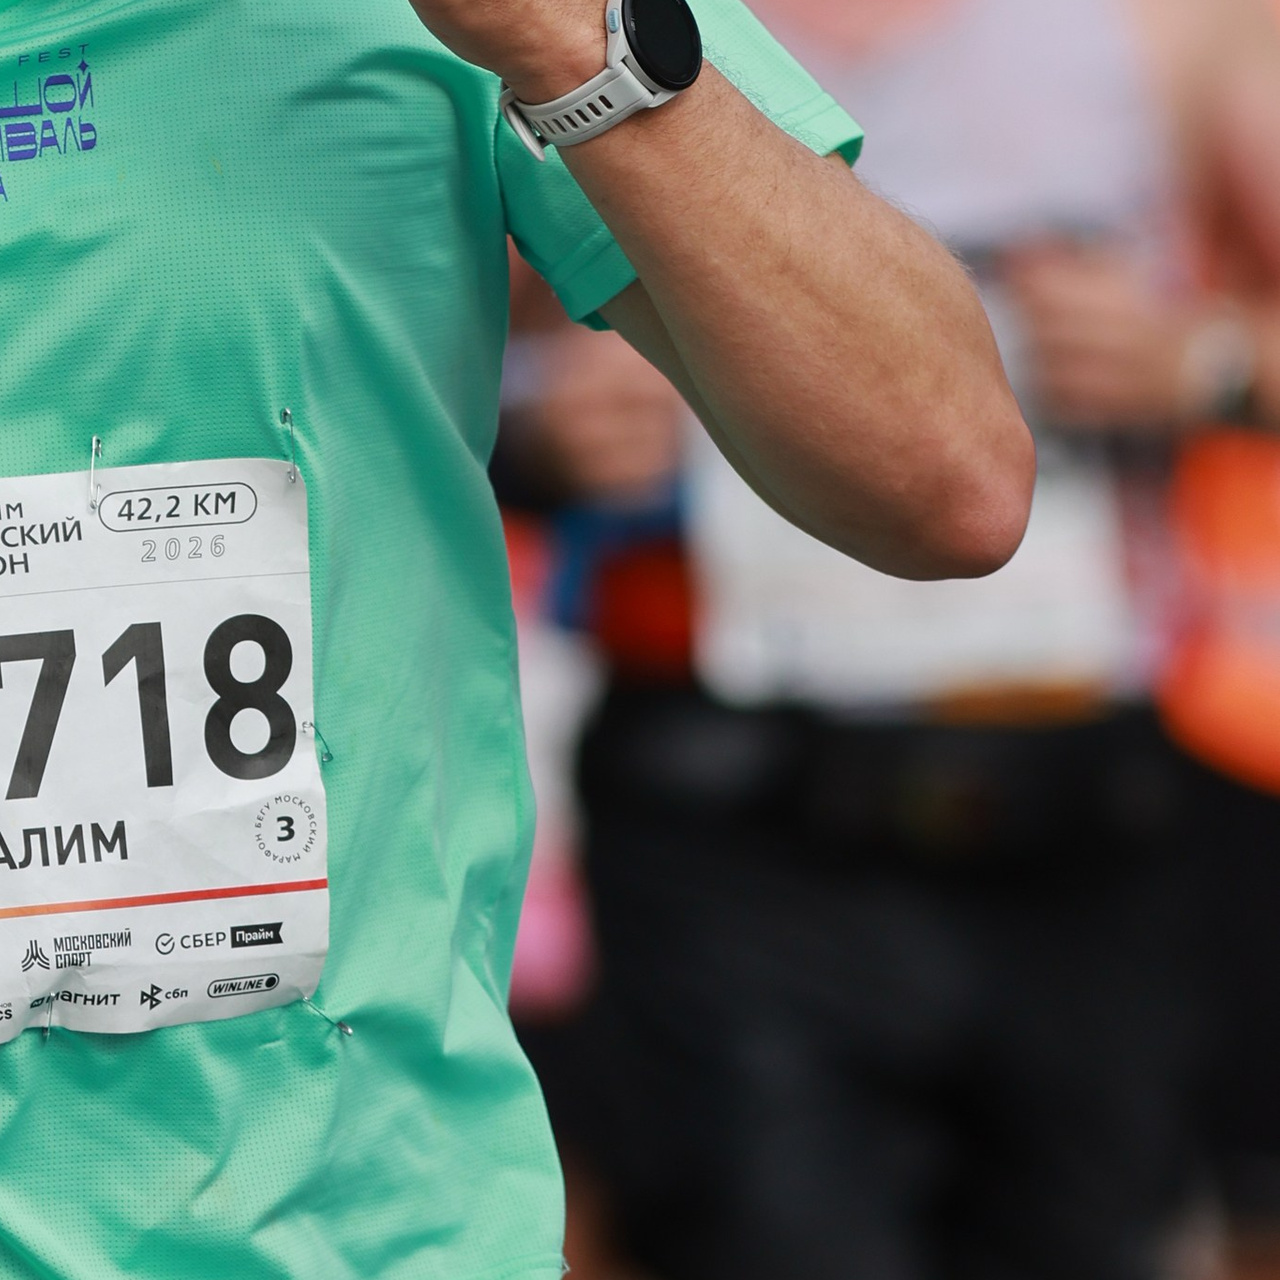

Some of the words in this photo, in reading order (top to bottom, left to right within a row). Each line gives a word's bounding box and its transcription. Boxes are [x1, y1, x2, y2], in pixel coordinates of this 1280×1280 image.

[18, 43, 90, 66] FEST
[117, 494, 181, 523] 42,2
[140, 534, 226, 563] 2026
[254, 801, 271, 829] БЕГУ
[274, 794, 318, 854] МОСКОВСКИЙ
[276, 815, 296, 842] 3
[255, 833, 302, 864] МАРАФОН
[53, 927, 132, 953] МОСКОВСКИЙ
[180, 931, 227, 949] СБЕР
[235, 928, 274, 944] Прайм
[55, 952, 93, 970] СПОРТ
[164, 988, 189, 1000] сбп
[212, 978, 264, 995] WINLINE
